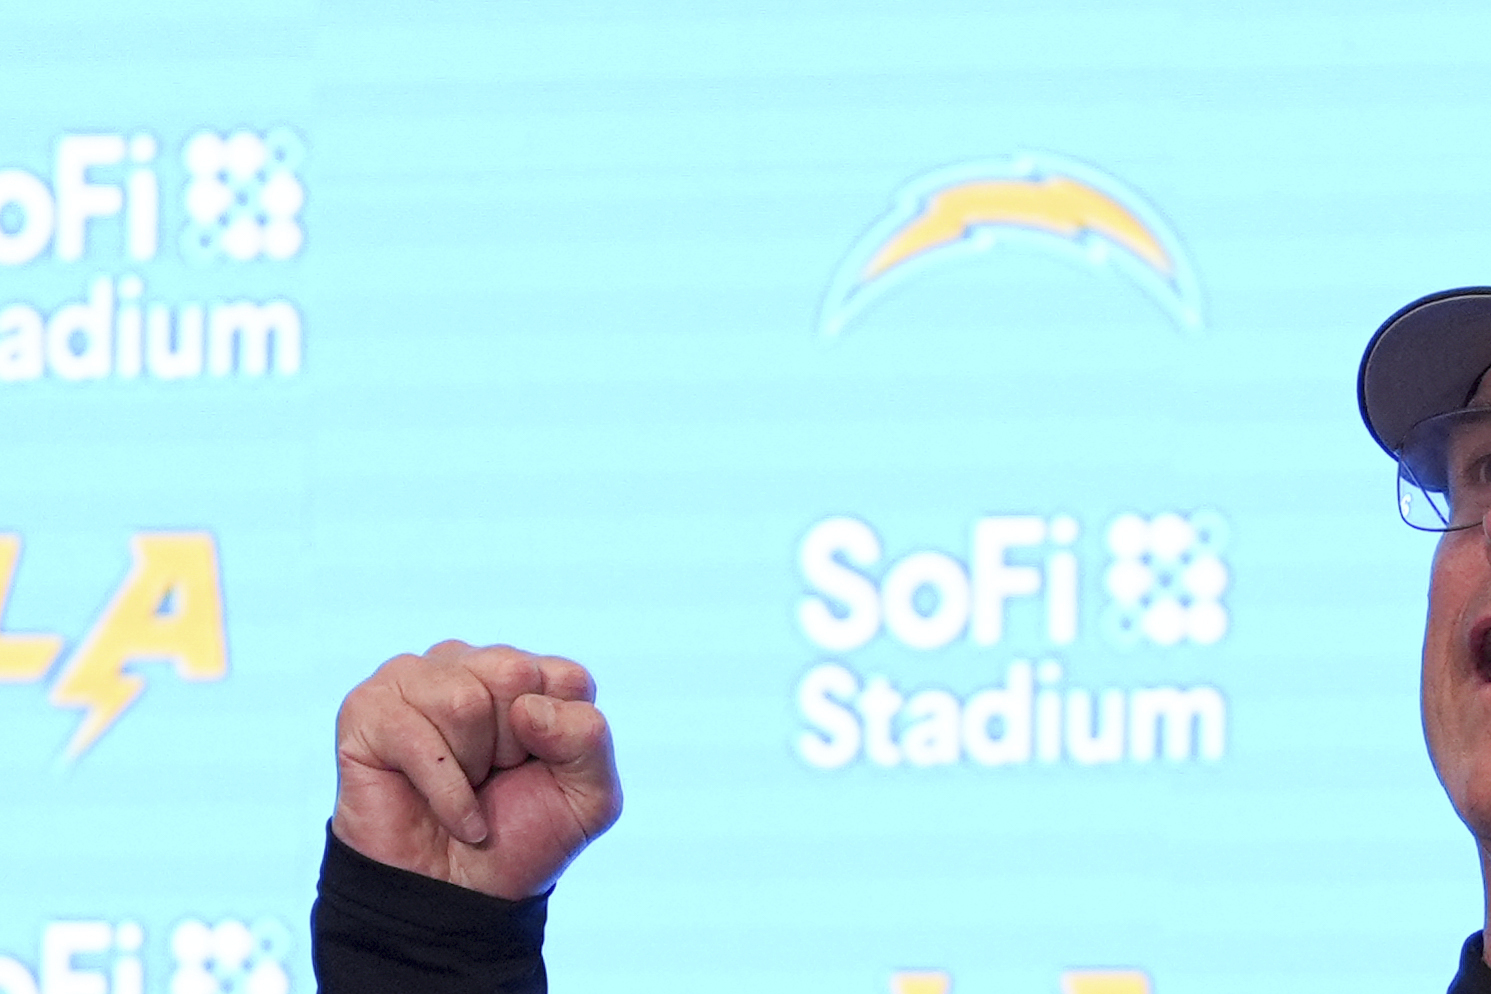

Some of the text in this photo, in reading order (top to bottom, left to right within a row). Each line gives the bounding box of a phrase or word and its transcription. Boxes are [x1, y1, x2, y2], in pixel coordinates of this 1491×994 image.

[0, 135, 158, 266] oFi
[0, 276, 300, 382] adium
[798, 515, 1078, 651] SoFi
[798, 662, 1225, 769] Stadium
